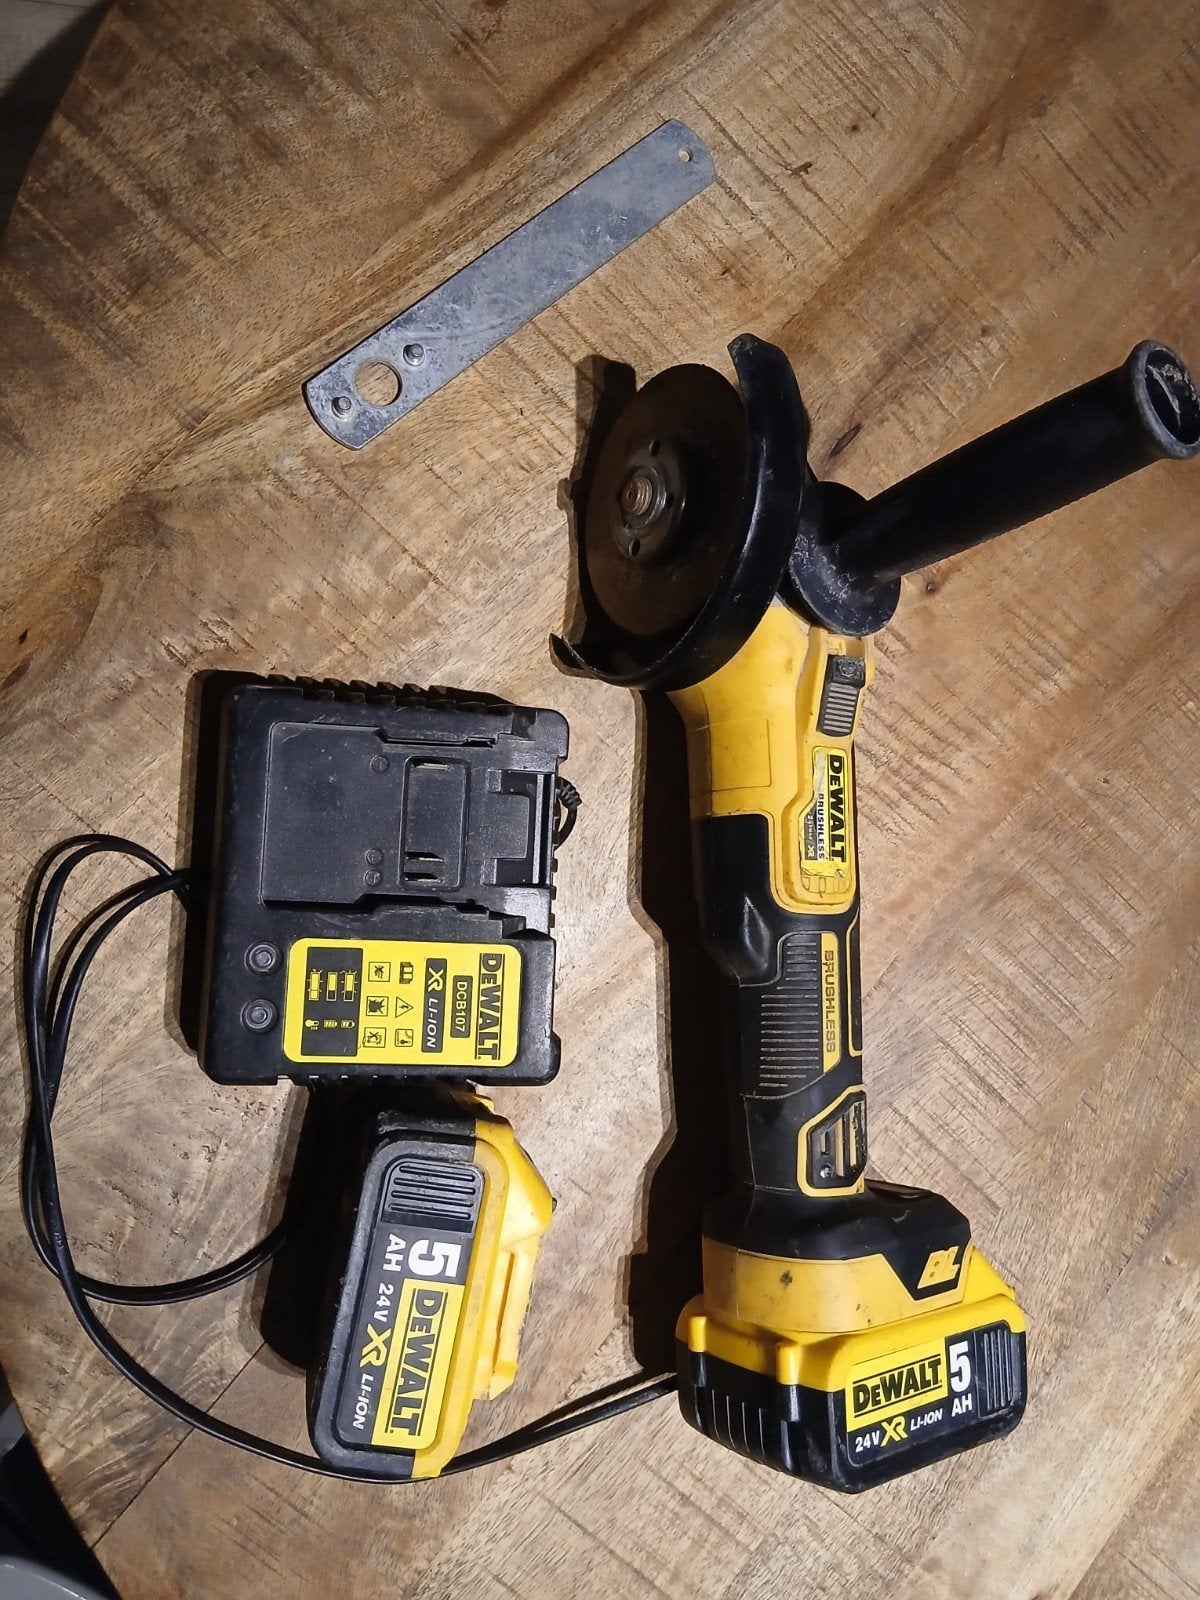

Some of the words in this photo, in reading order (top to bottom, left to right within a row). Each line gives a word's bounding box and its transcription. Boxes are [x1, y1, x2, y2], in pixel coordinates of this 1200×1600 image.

[817, 793, 825, 860] BRUSHLESS
[829, 754, 845, 863] DeWALT
[428, 966, 444, 993] XR
[455, 981, 466, 1032] DCB107
[478, 953, 502, 1060] DeWALT
[824, 950, 836, 1053] BRUSHLESS
[426, 997, 439, 1049] LI-ION
[382, 1233, 406, 1271] AH
[408, 1239, 462, 1278] 5
[372, 1282, 394, 1323] 24V
[359, 1323, 391, 1368] XR
[390, 1289, 443, 1435] DeWALT
[352, 1373, 374, 1429] LI-ION
[853, 1357, 942, 1414] DeWALT
[949, 1340, 971, 1393] 5
[855, 1430, 880, 1453] 24V
[880, 1415, 908, 1447] XR
[910, 1407, 943, 1431] LI-ION
[951, 1393, 973, 1417] AH
